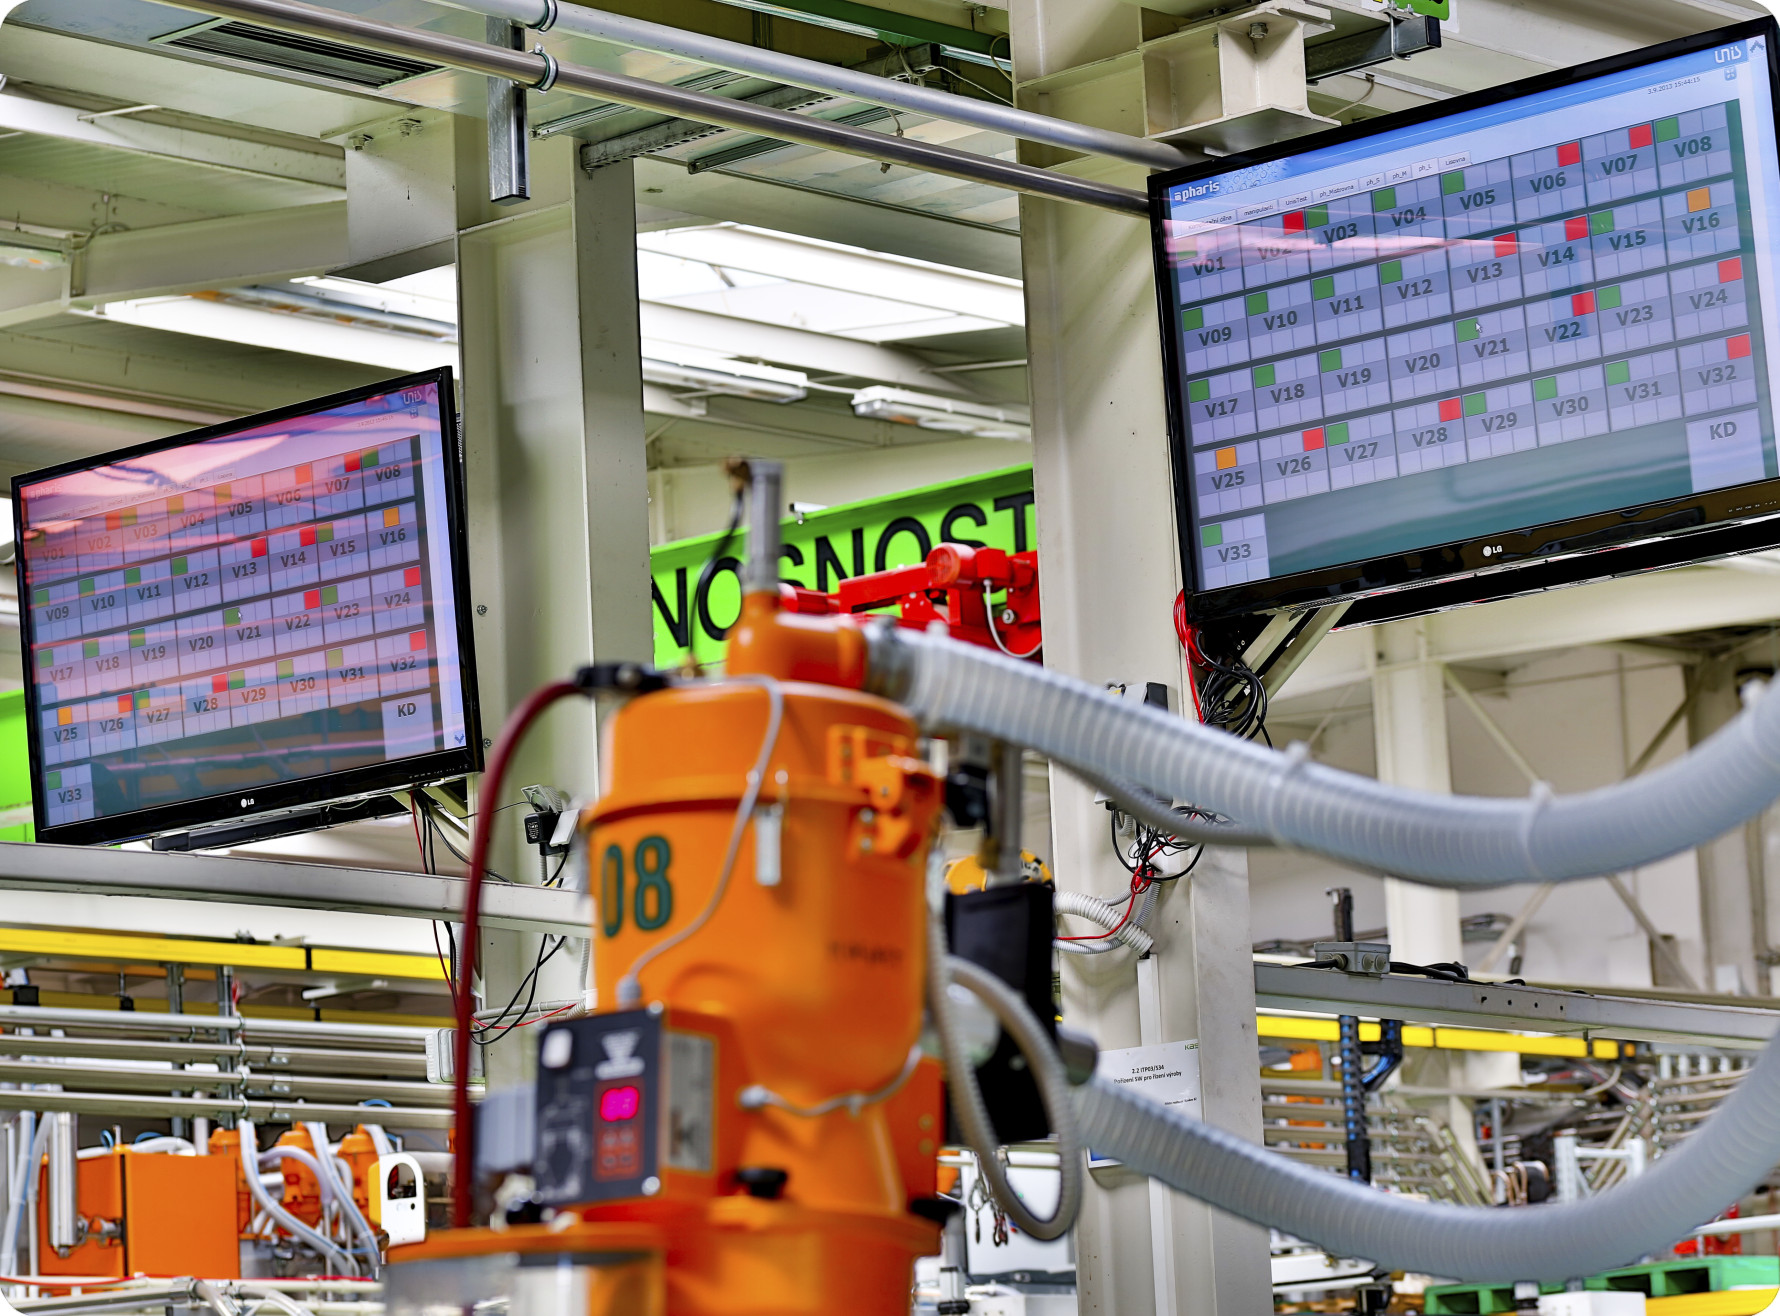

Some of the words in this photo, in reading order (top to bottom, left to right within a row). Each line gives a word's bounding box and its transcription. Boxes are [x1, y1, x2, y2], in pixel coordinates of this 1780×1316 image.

[1674, 136, 1712, 157] V08
[1601, 154, 1637, 175] V07
[1530, 172, 1566, 193] V06
[1460, 189, 1495, 210] V05
[1391, 207, 1426, 226] V04
[1682, 211, 1719, 234] V16
[1323, 223, 1357, 243] V03
[1609, 230, 1646, 251] V15
[1257, 242, 1292, 260] V02
[1537, 246, 1574, 267] V14
[1193, 256, 1226, 276] V01
[1467, 262, 1502, 283] V13
[1397, 279, 1432, 299] V12
[1330, 296, 1364, 315] V11
[1689, 289, 1728, 309] V24
[1263, 311, 1297, 330] V10
[1616, 305, 1653, 326] V23
[1198, 327, 1231, 346] V09
[1544, 322, 1581, 342] V22
[1474, 338, 1509, 358] V21
[1405, 353, 1440, 373] V20
[1337, 368, 1371, 388] V19
[1698, 365, 1736, 385] V32
[1270, 384, 1304, 403] V18
[1624, 381, 1661, 401] V31
[1205, 398, 1238, 417] V17
[1552, 396, 1588, 416] V30
[1481, 412, 1517, 432] V29
[1710, 422, 1736, 440] KD
[1412, 427, 1447, 447] V28
[1344, 442, 1378, 461] V27
[375, 464, 401, 481] V08
[1277, 456, 1311, 476] V26
[325, 478, 350, 494] V07
[1211, 471, 1244, 490] V25
[277, 490, 301, 506] V06
[227, 501, 252, 517] V05
[181, 513, 205, 529] V04
[134, 524, 158, 540] V03
[380, 528, 406, 545] V16
[88, 536, 112, 551] V02
[330, 540, 355, 556] V15
[42, 545, 66, 562] V01
[281, 551, 306, 567] V14
[1218, 544, 1251, 562] V33
[232, 562, 256, 578] V13
[184, 573, 208, 589] V12
[137, 585, 161, 600] V11
[384, 592, 411, 608] V24
[91, 595, 115, 610] V10
[334, 603, 359, 619] V23
[46, 606, 69, 621] V09
[285, 614, 310, 630] V22
[237, 626, 261, 641] V21
[189, 636, 213, 651] V20
[142, 646, 165, 661] V19
[96, 656, 119, 672] V18
[391, 656, 418, 672] V32
[50, 666, 73, 681] V17
[339, 667, 365, 682] V31
[290, 677, 315, 692] V30
[241, 688, 266, 703] V29
[193, 698, 218, 713] V28
[398, 703, 416, 717] KD
[146, 708, 170, 723] V27
[100, 717, 123, 733] V26
[54, 727, 77, 742] V25
[58, 788, 81, 803] V33
[602, 836, 671, 937] 08
